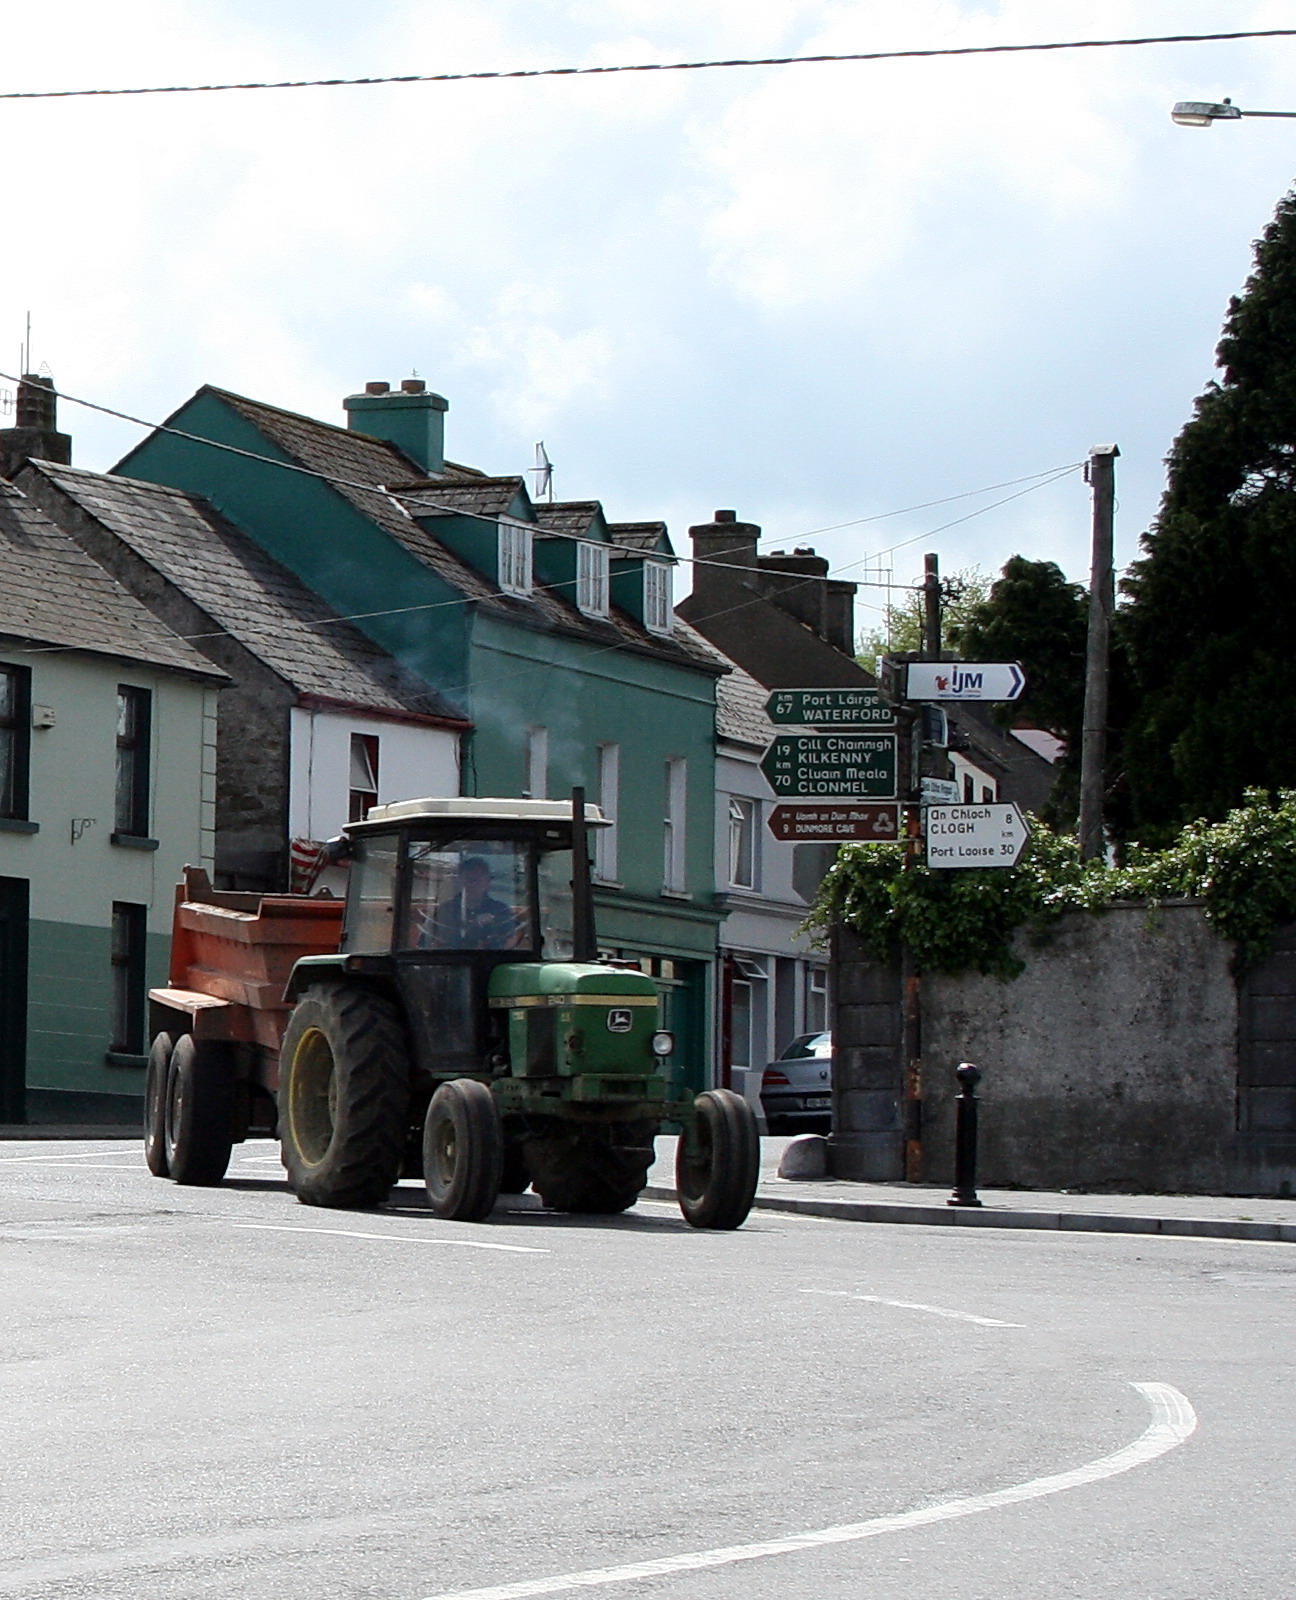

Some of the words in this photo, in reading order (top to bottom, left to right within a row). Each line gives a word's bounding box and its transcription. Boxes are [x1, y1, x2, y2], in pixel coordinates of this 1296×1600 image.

[802, 694, 832, 705] Port
[776, 703, 793, 714] 67
[802, 709, 891, 720] WATERFORD
[797, 738, 821, 750] Cill
[777, 745, 791, 756] 19
[798, 753, 872, 764] KILKENNY
[776, 761, 791, 769] km
[775, 775, 791, 786] 70
[797, 782, 868, 793] CLONMEL
[931, 809, 947, 820] An
[1005, 813, 1013, 824] 8
[795, 824, 834, 833] DUNMORE
[836, 824, 856, 833] CAVE
[930, 823, 975, 834] CLOGH
[930, 846, 954, 857] Port
[958, 846, 995, 856] Laoise
[1000, 844, 1014, 855] 30
